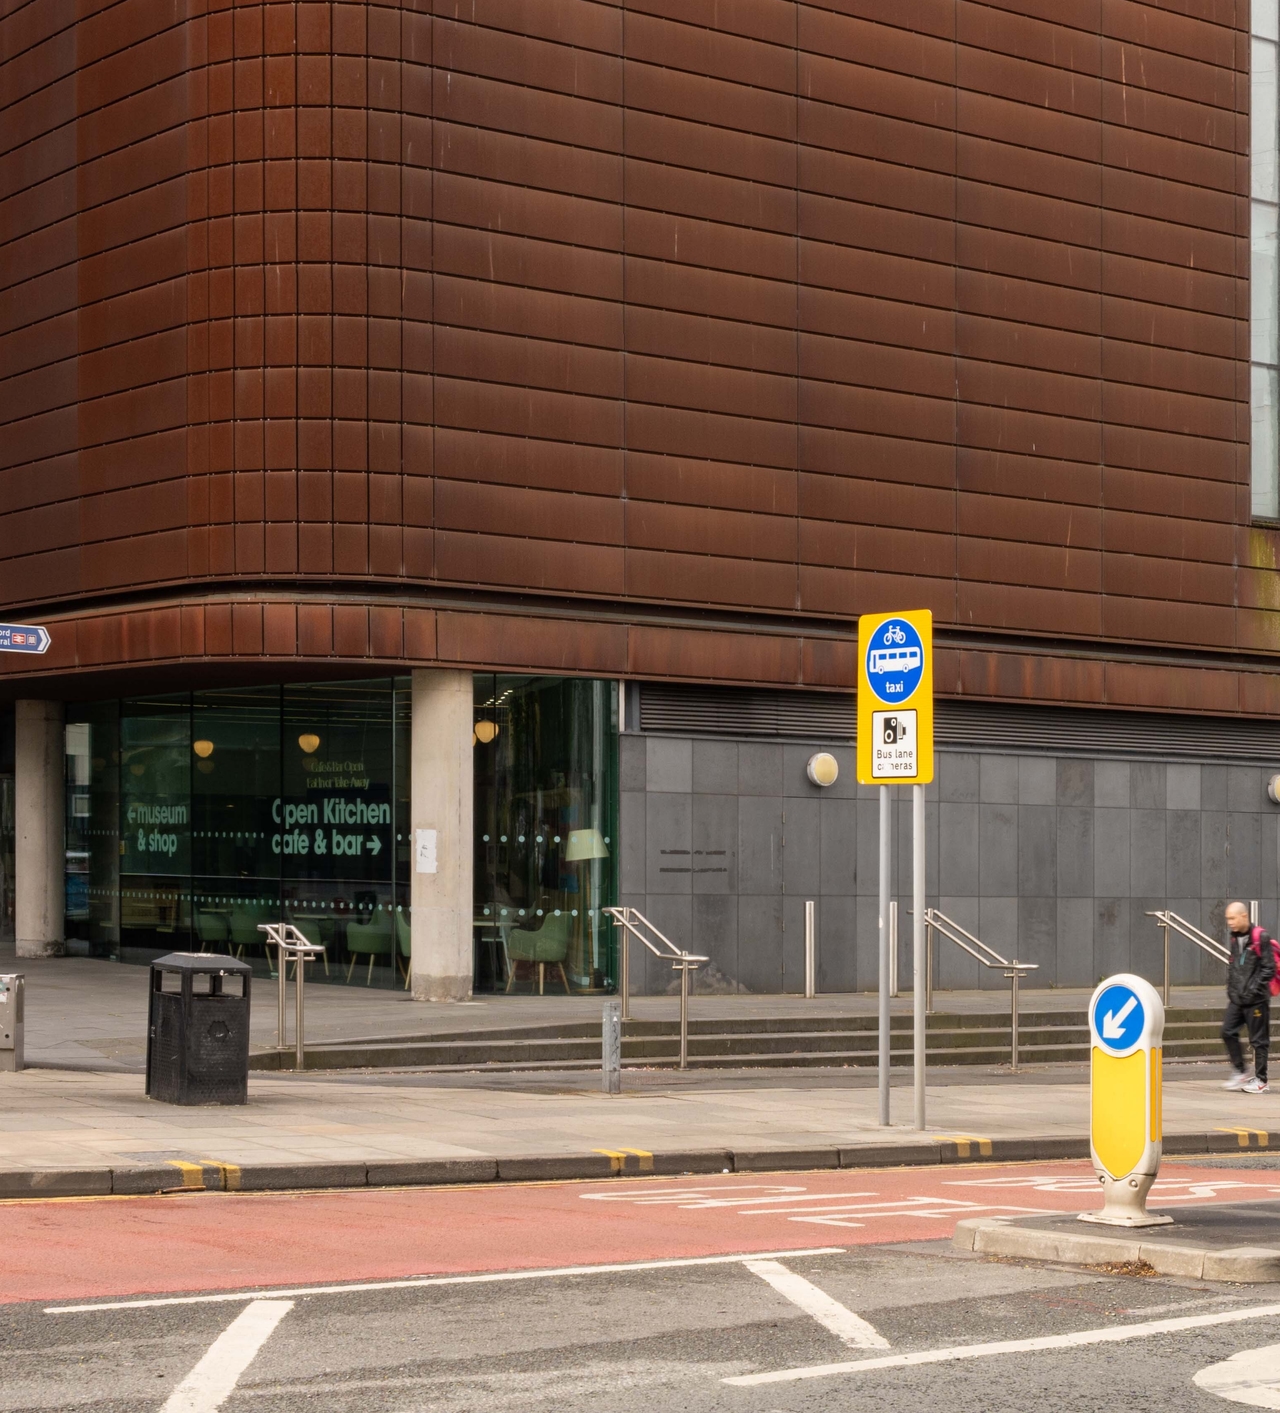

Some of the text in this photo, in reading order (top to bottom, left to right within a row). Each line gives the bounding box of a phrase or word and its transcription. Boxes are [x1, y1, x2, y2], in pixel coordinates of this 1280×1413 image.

[886, 681, 904, 693] taxi
[877, 749, 913, 759] Bus lane
[137, 805, 186, 824] museum
[272, 798, 390, 829] Open Kitchen
[138, 828, 177, 857] & shop
[272, 829, 364, 855] cafe & bar
